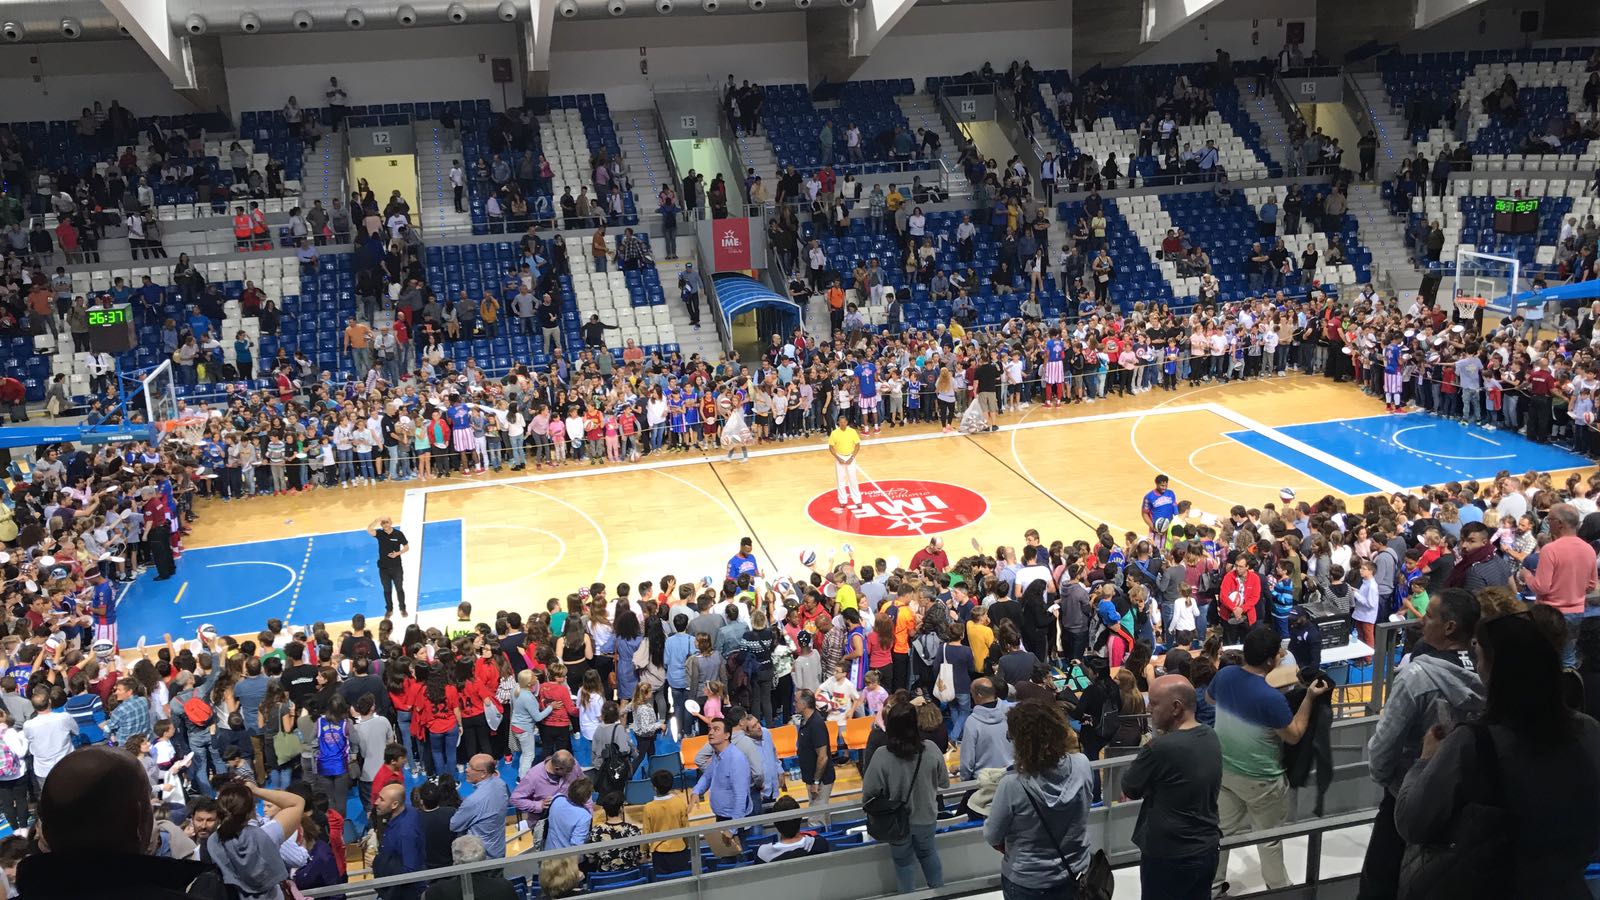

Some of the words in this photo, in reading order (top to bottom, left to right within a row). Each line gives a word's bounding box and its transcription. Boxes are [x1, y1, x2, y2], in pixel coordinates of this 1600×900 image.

[1303, 83, 1313, 92] 15
[962, 102, 974, 111] 14
[683, 117, 695, 126] 13
[375, 134, 388, 143] 12
[721, 238, 740, 247] IME
[89, 310, 123, 324] 26:37
[847, 495, 948, 518] IME
